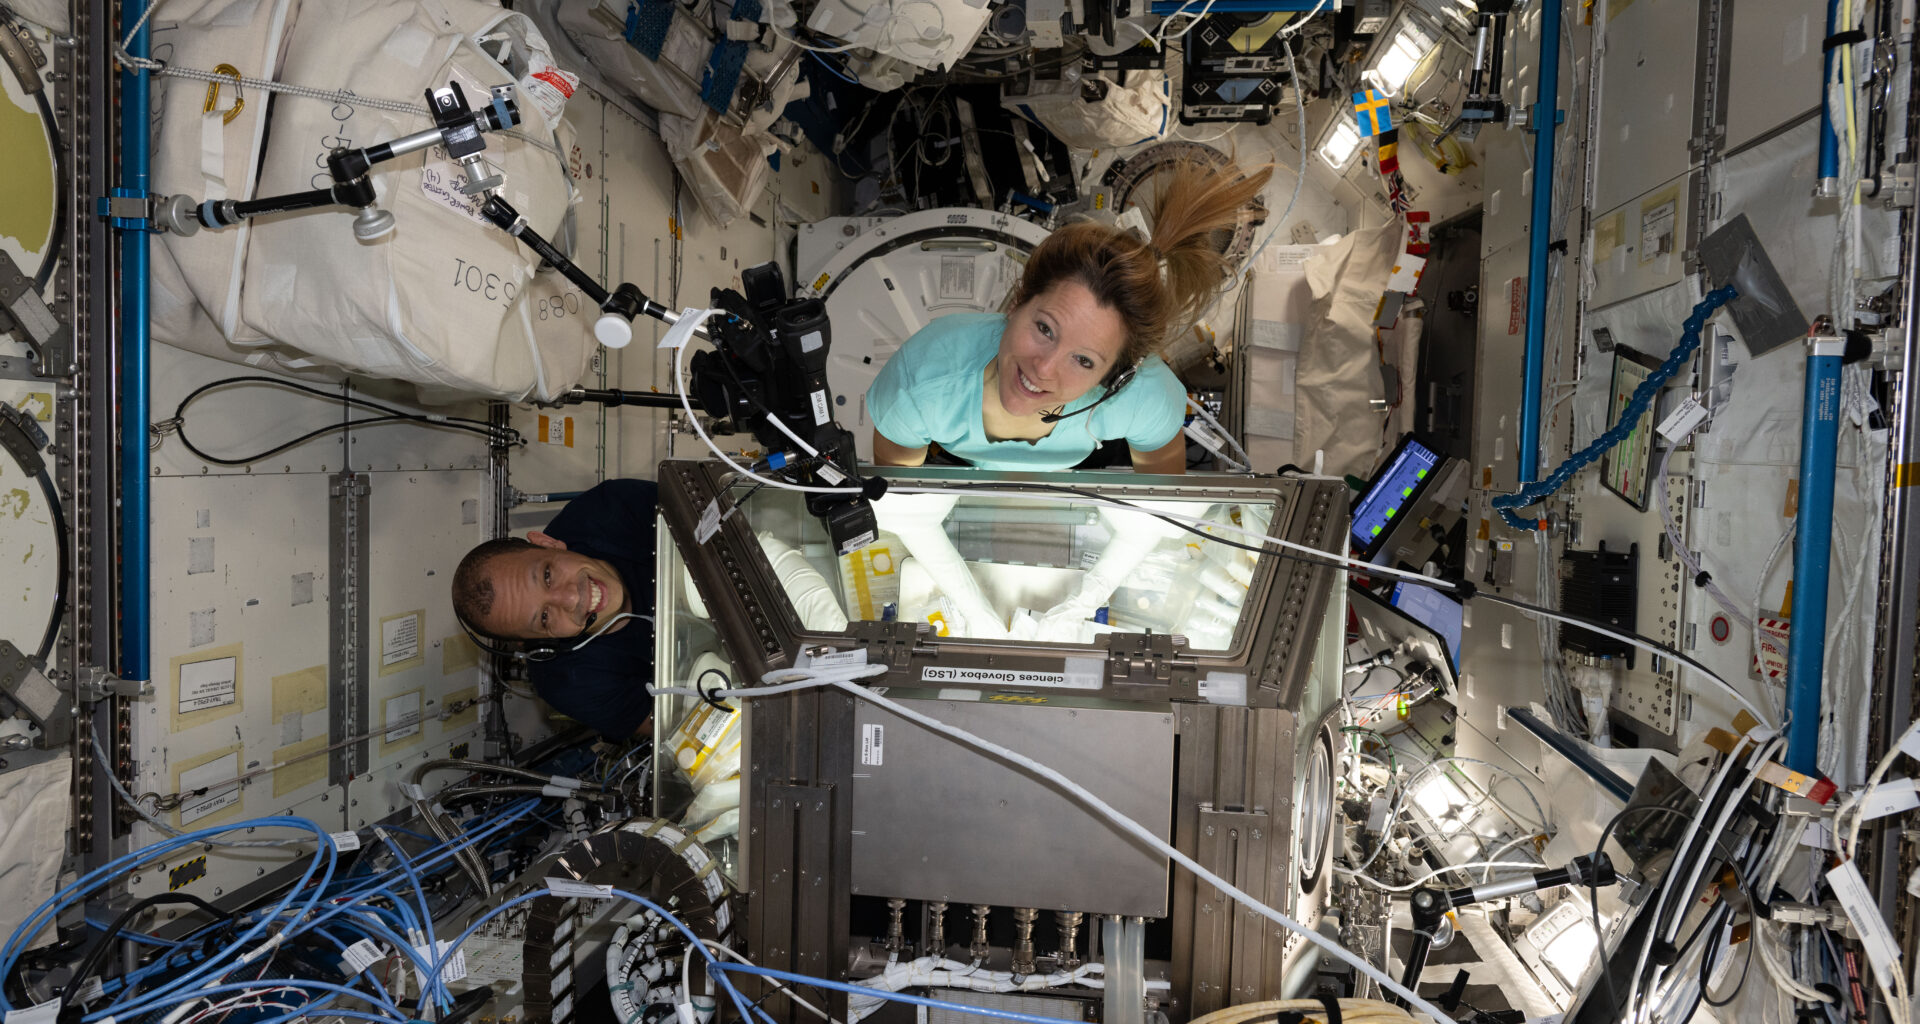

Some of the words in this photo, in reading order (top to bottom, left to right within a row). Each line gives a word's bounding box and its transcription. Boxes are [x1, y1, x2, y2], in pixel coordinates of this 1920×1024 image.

[1761, 642, 1777, 654] FIRE
[923, 668, 957, 680] (LSG)
[960, 670, 1015, 682] Glovebox
